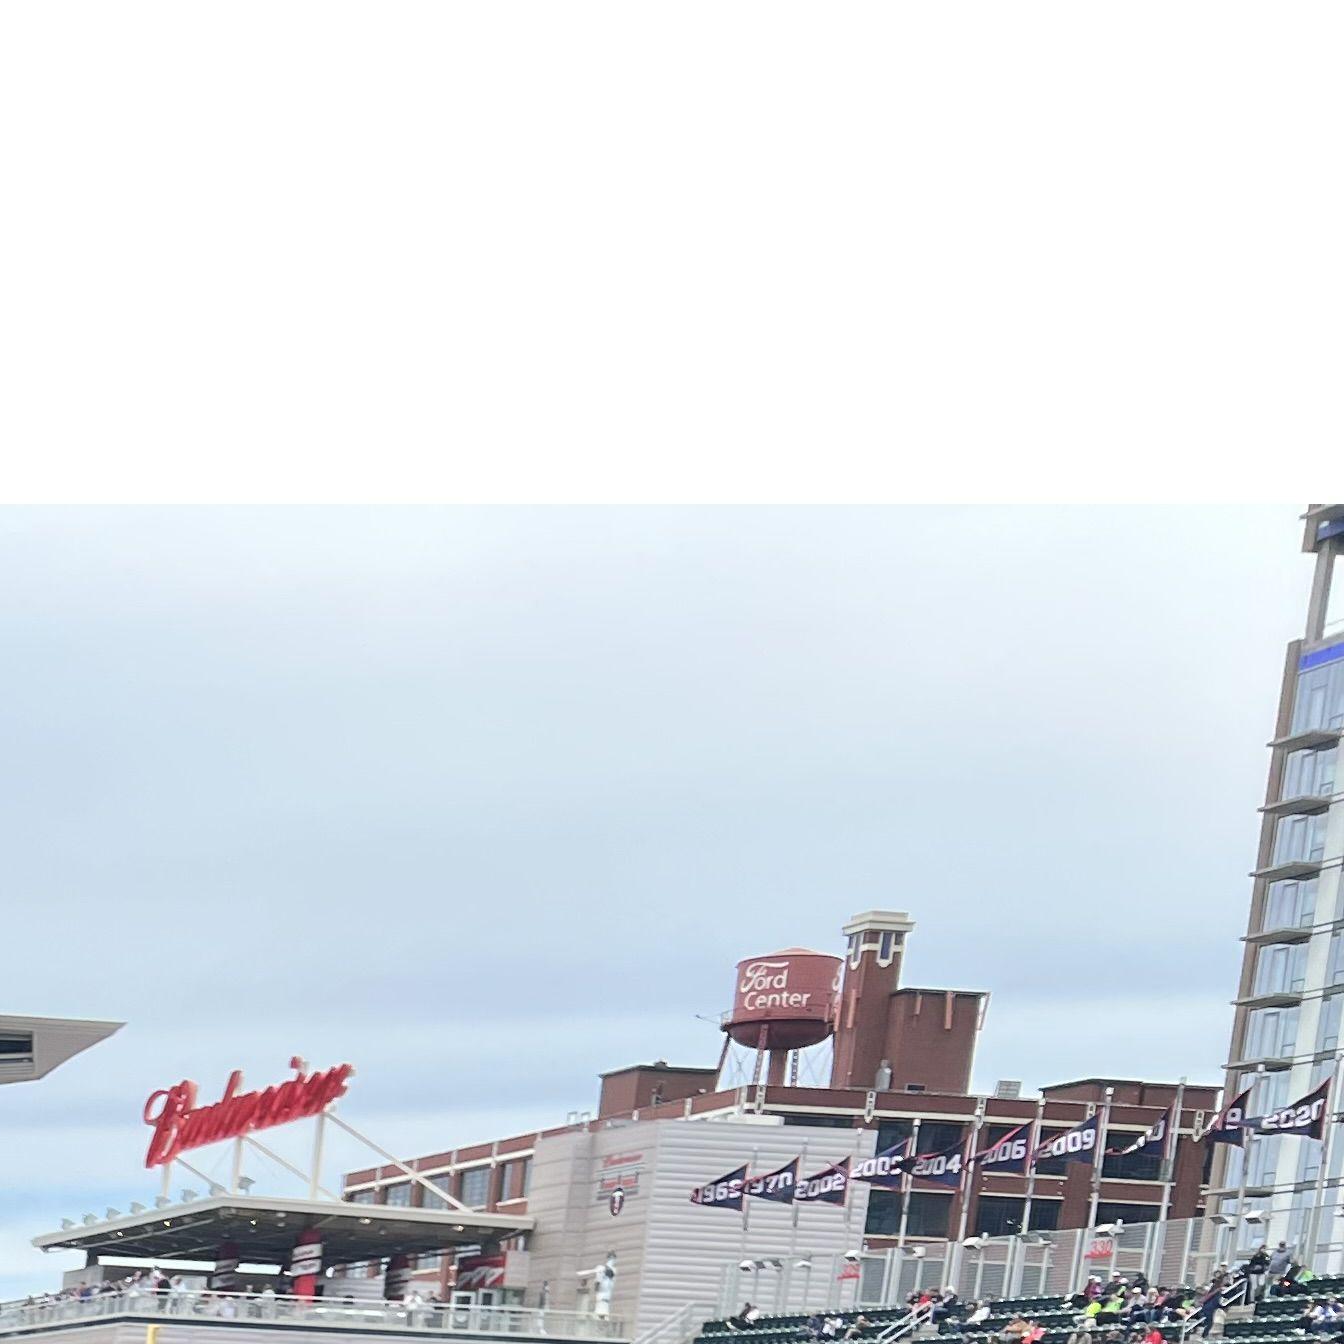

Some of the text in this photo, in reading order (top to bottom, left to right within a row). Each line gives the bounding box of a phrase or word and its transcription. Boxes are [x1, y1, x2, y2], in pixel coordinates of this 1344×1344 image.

[740, 961, 789, 993] Ford
[744, 991, 811, 1010] Center
[912, 1153, 962, 1176] 2004
[794, 1174, 846, 1199] 2002
